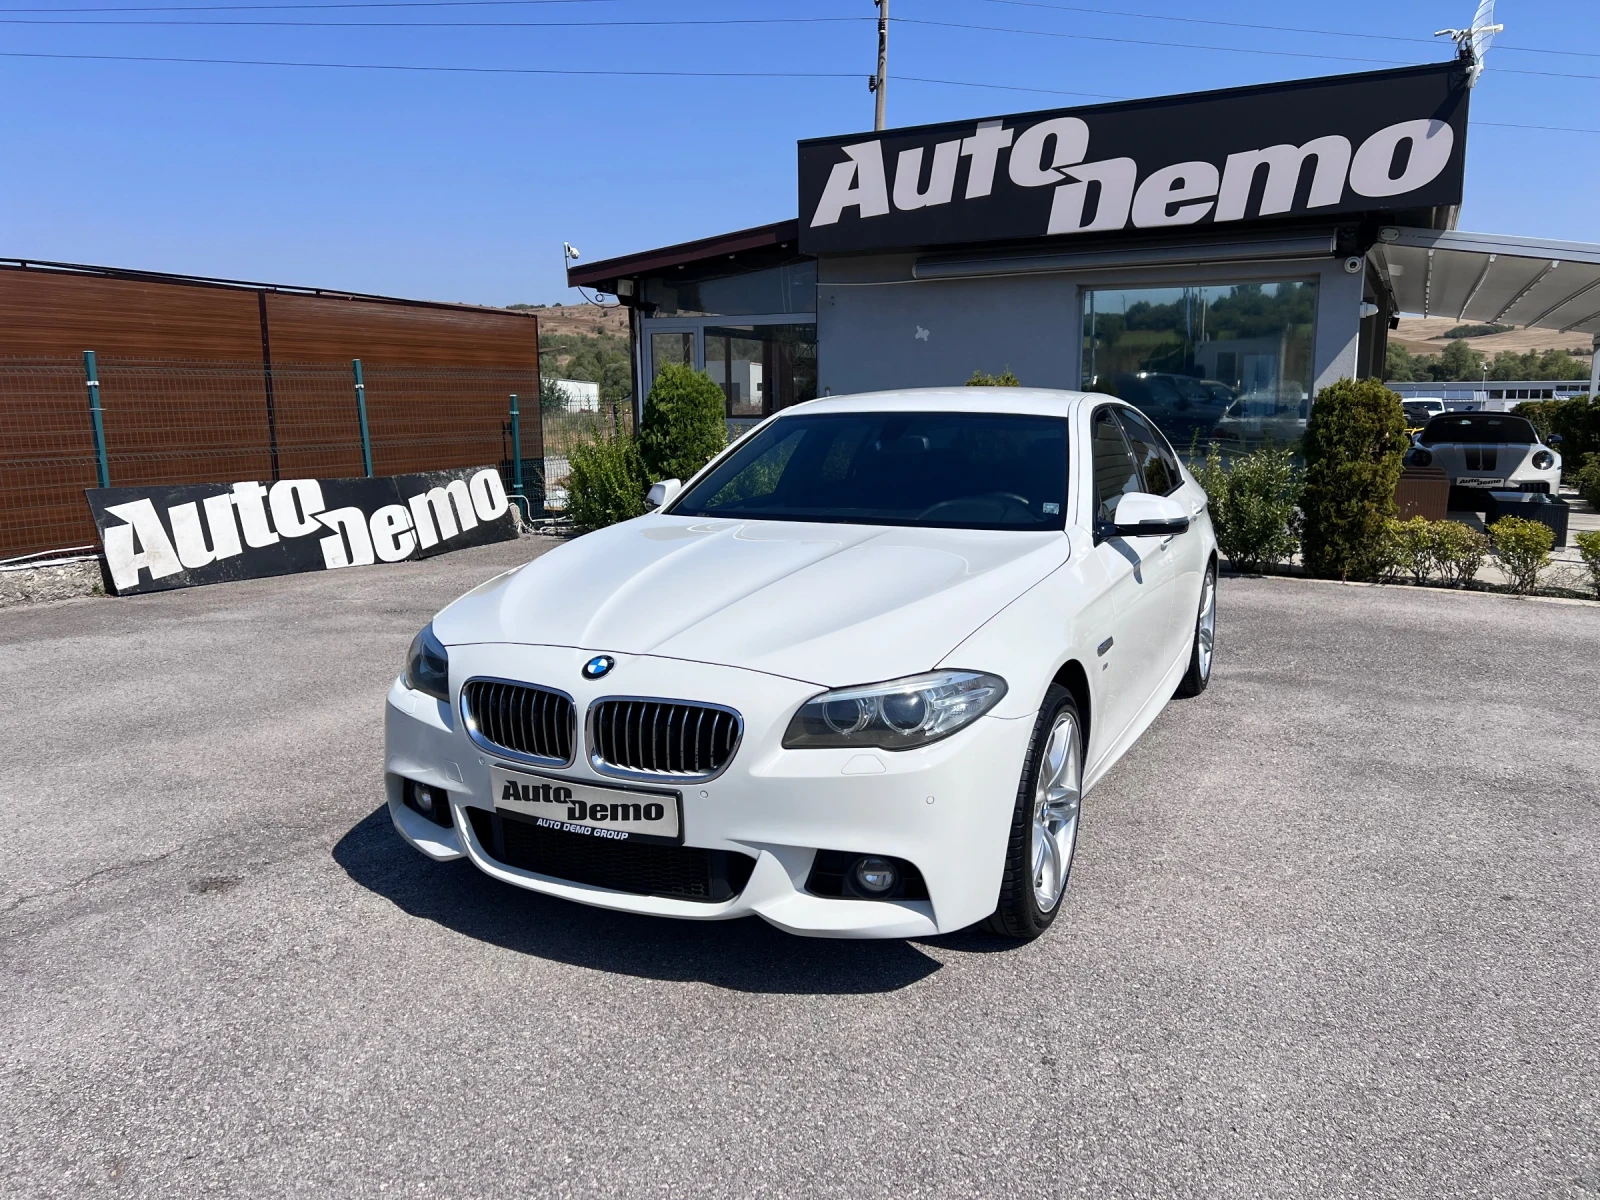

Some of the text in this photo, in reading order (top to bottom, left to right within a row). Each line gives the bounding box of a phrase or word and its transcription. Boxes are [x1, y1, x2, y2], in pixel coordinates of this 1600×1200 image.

[810, 116, 1455, 235] Auto Demo
[104, 468, 508, 591] Auto Demo
[502, 780, 665, 821] Auto Demo
[536, 818, 629, 841] AUTO DEMO GROUP
